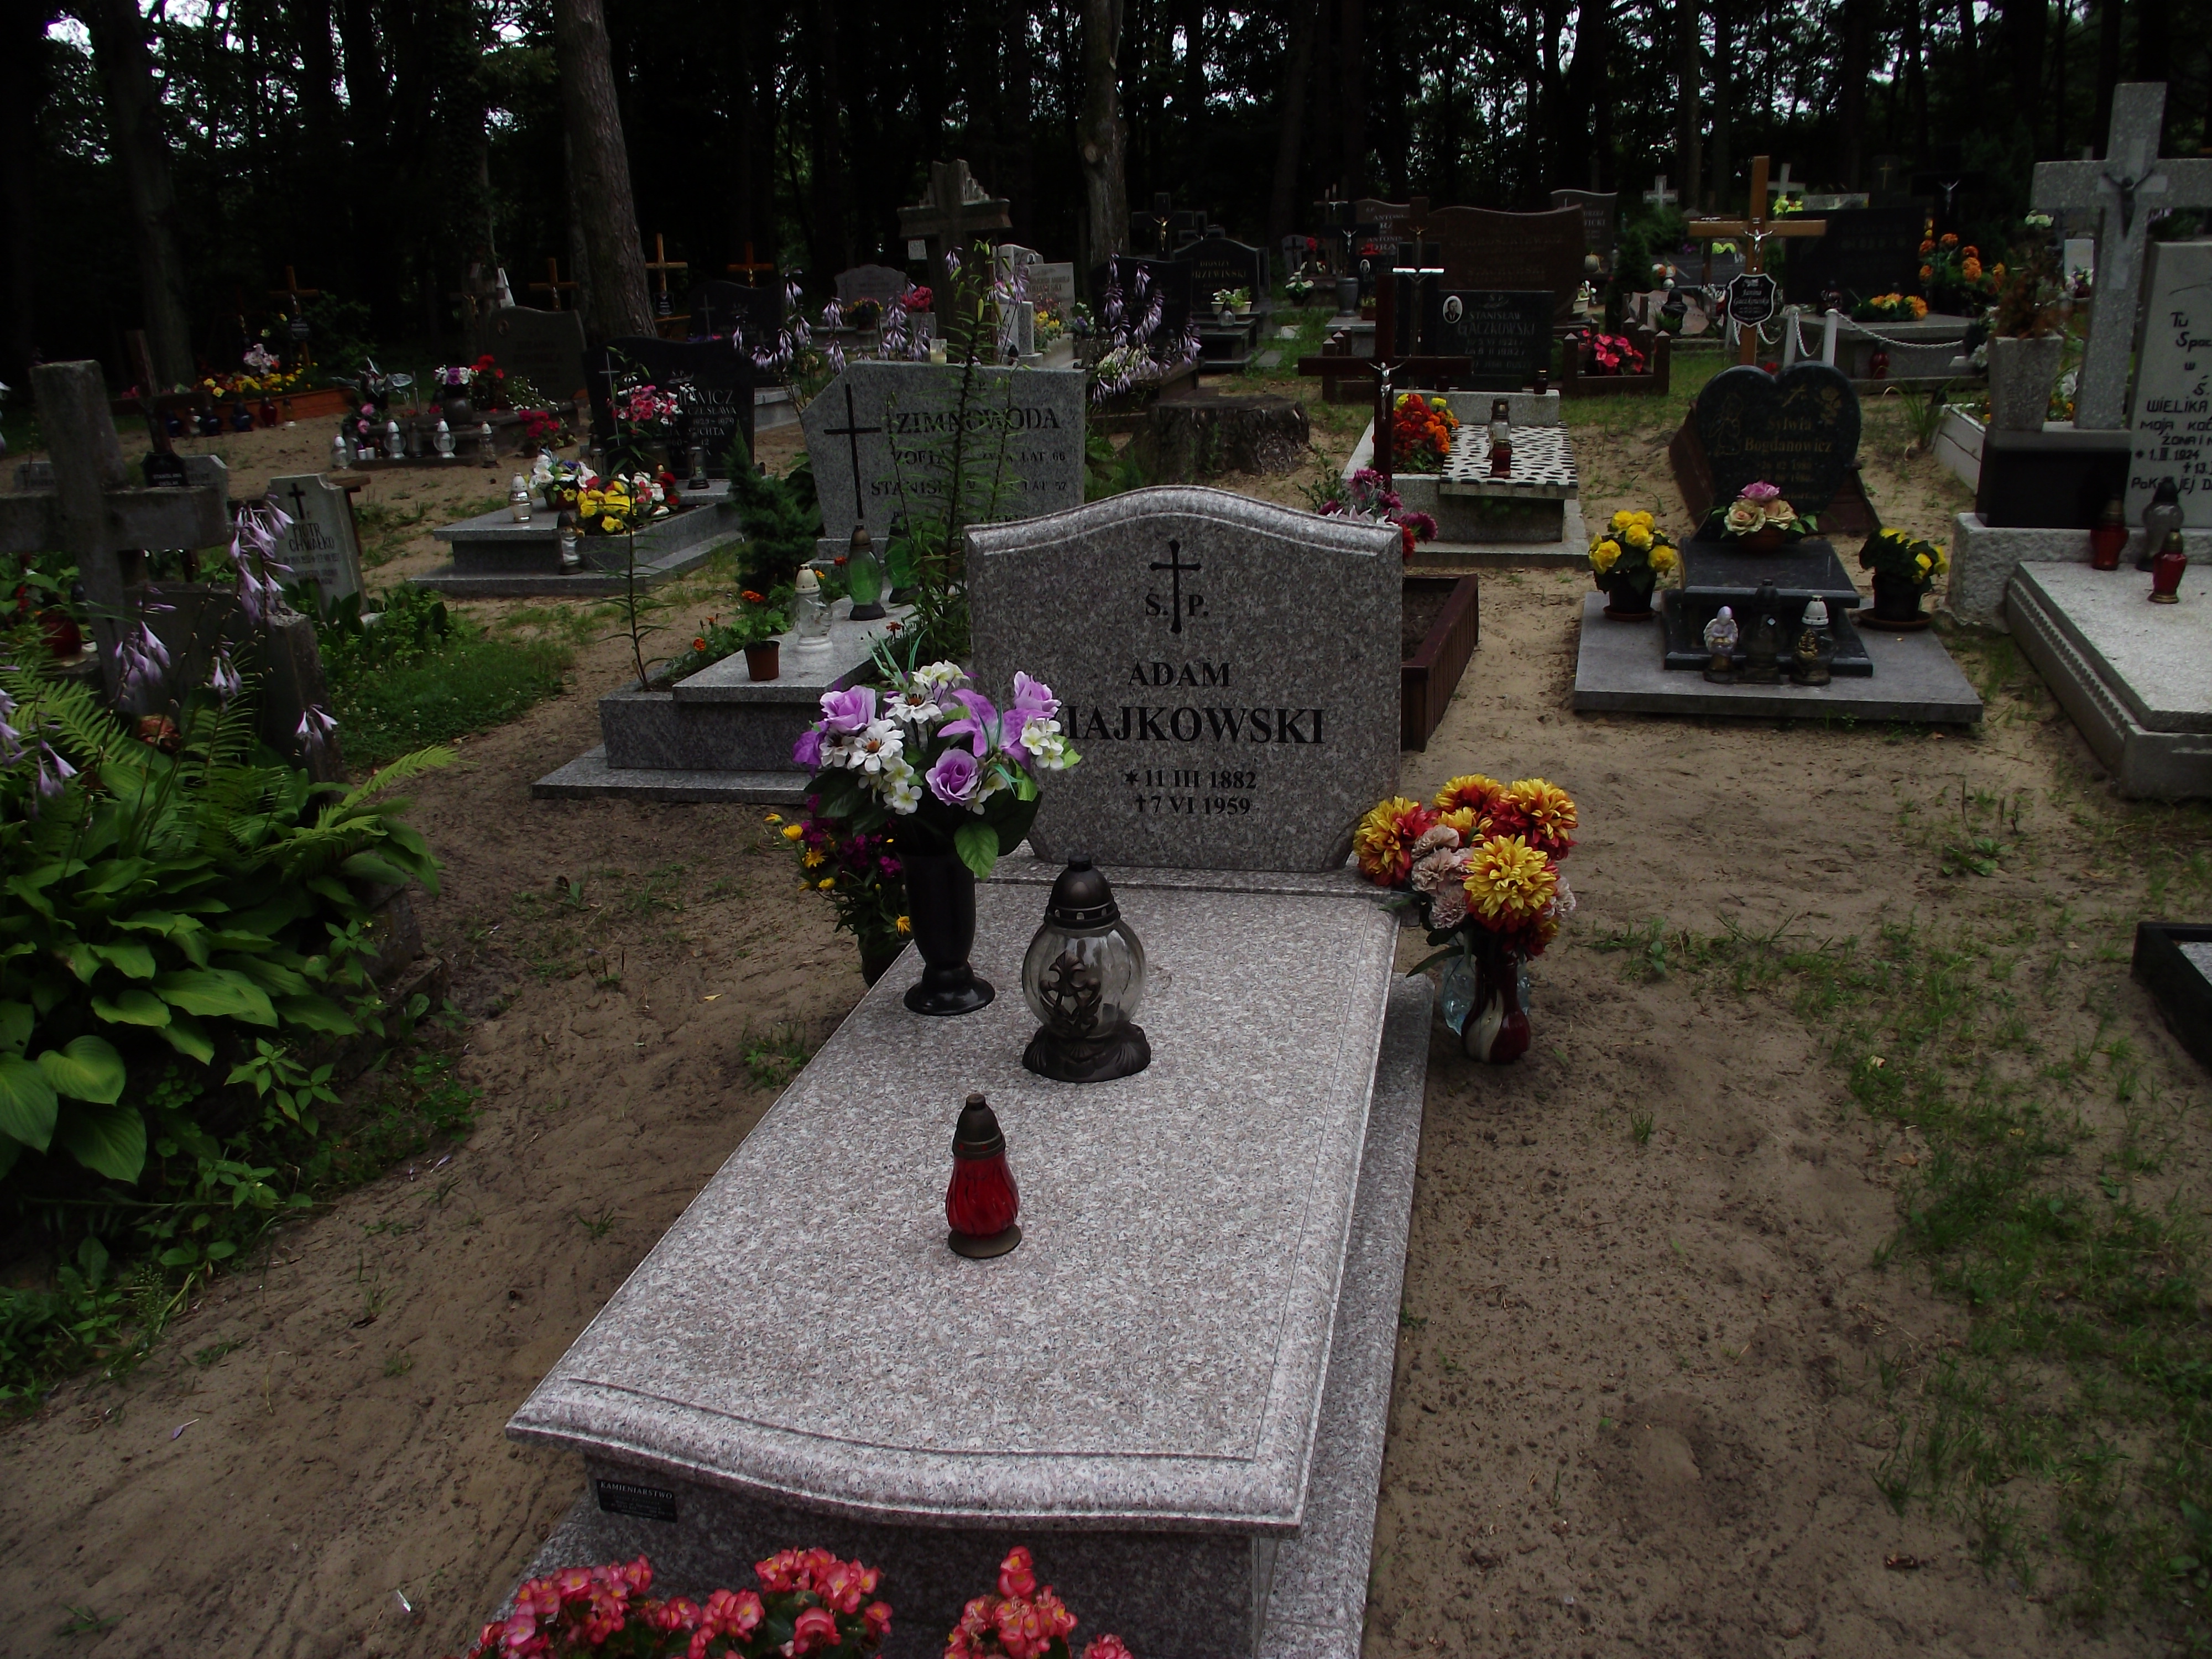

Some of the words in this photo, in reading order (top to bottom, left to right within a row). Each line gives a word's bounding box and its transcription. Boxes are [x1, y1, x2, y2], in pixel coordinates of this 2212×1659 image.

[1457, 322, 1536, 336] GACZKOWSKI
[896, 408, 1061, 434] ZIMNOWODA
[1767, 416, 1813, 433] Sylwia
[1744, 436, 1833, 455] Bogdanowicz
[289, 536, 335, 552] CHWAŁKO
[1128, 661, 1230, 687] ADAM
[1060, 705, 1326, 744] IAJKOWSKI
[1145, 769, 1164, 786] 11
[1175, 770, 1199, 787] III
[1211, 770, 1257, 789] 1882
[1151, 796, 1161, 813] 7
[1169, 796, 1193, 814] VI
[1204, 795, 1250, 815] 1959
[601, 1481, 672, 1500] KAMIENIARSTWO
